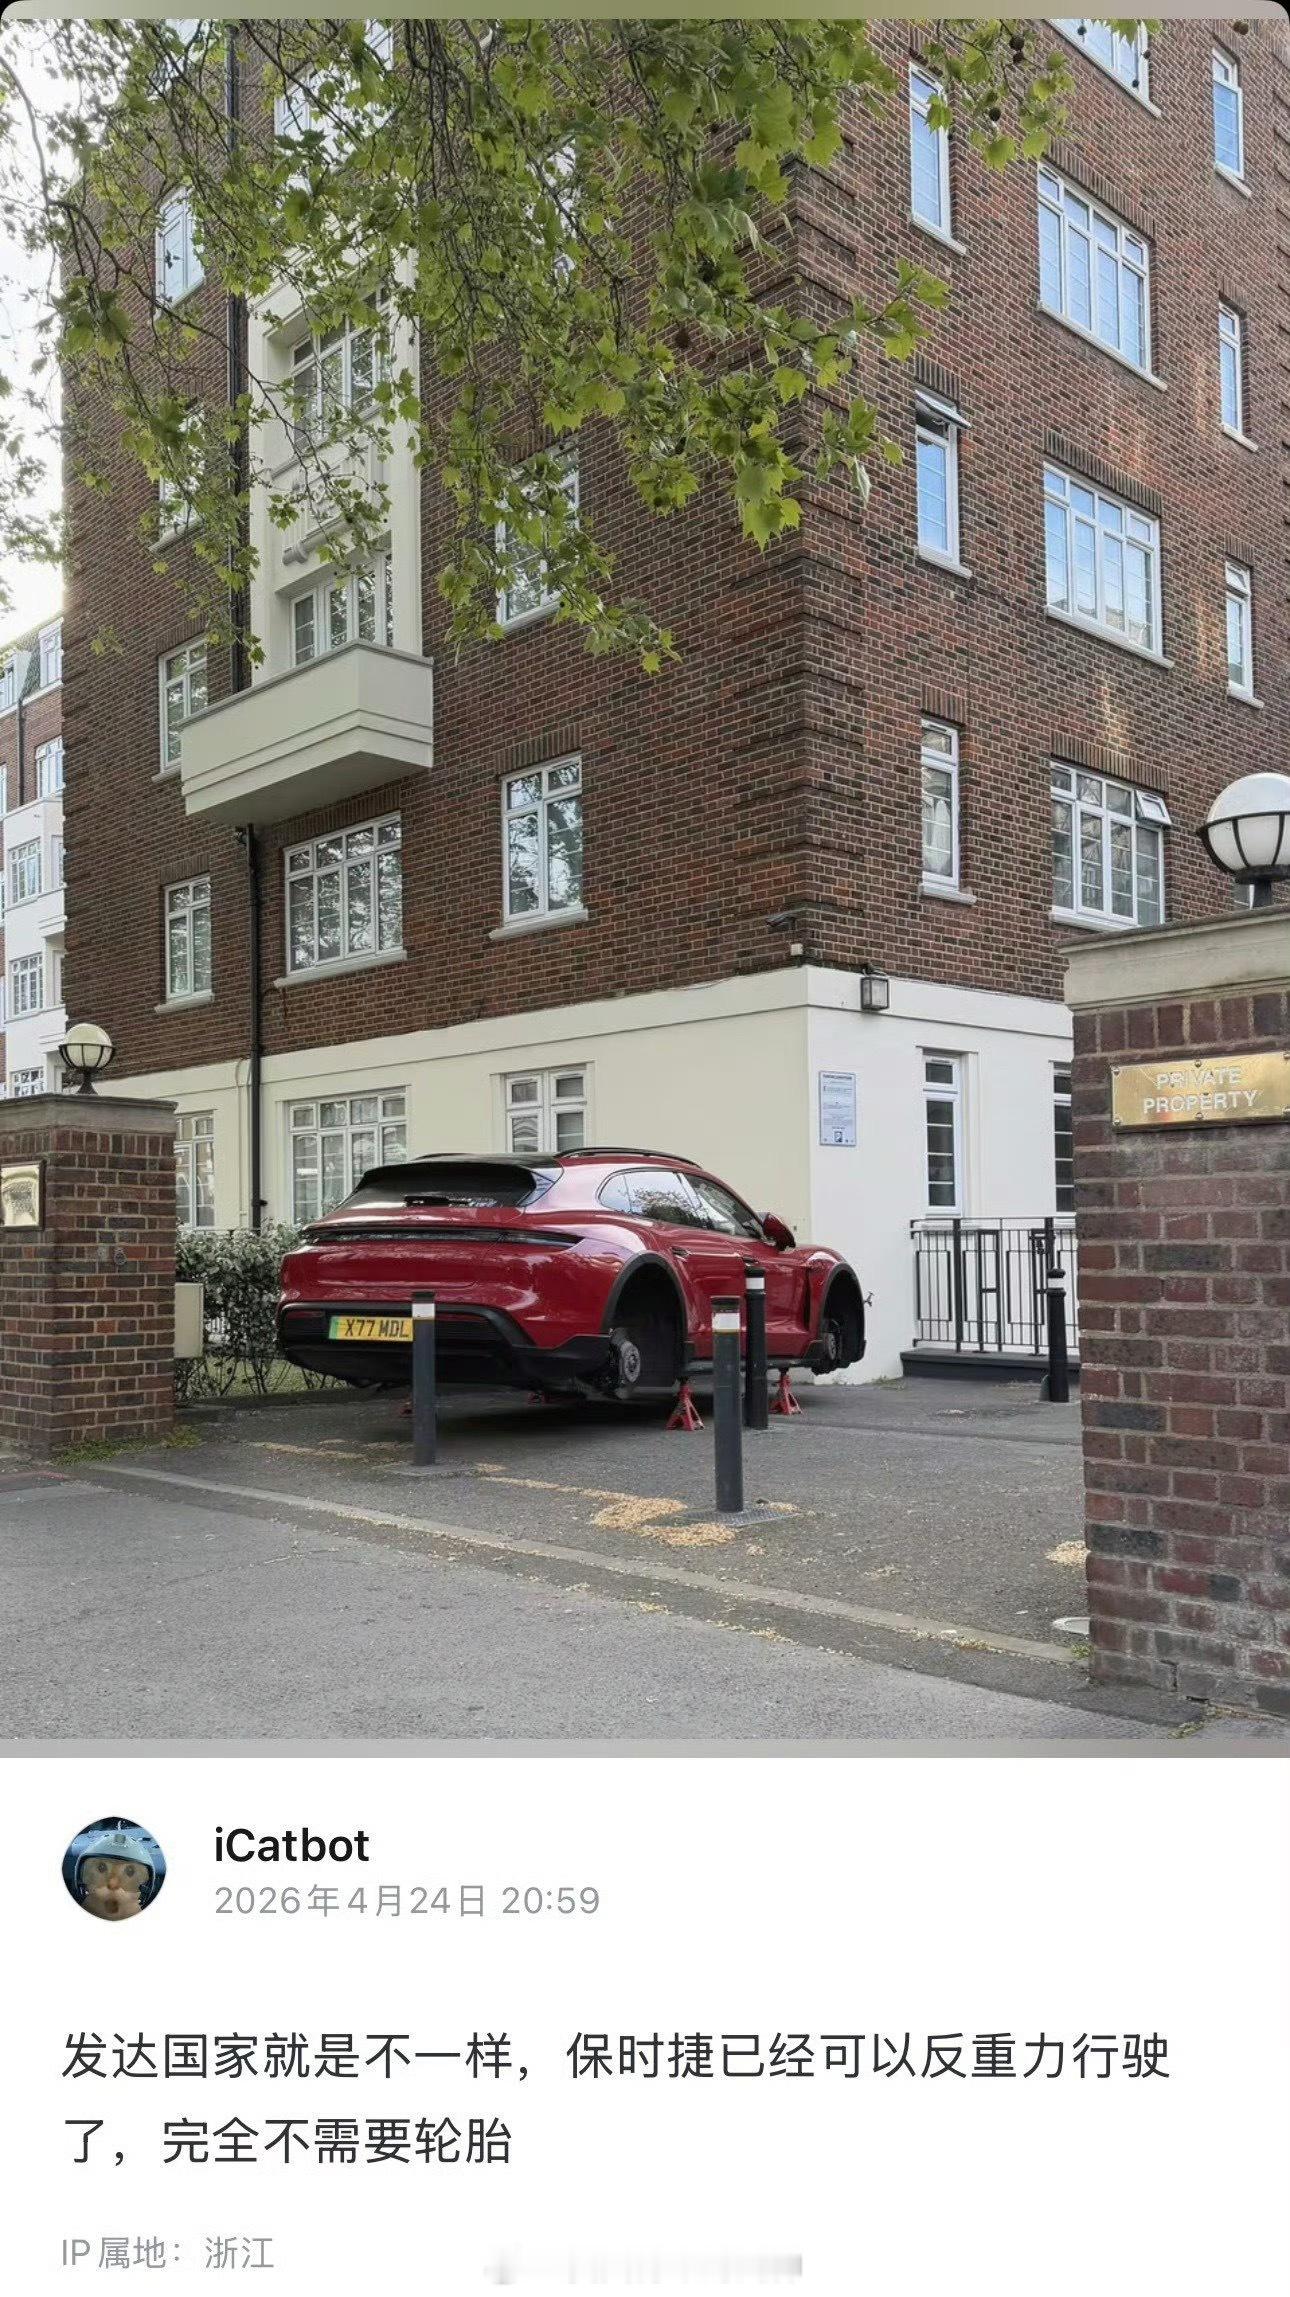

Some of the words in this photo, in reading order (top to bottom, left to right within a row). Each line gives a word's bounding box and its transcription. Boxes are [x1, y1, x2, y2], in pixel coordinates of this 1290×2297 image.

[1156, 1067, 1242, 1090] PRIVATE
[1143, 1090, 1259, 1114] PROPERTY
[344, 1319, 376, 1337] X77
[378, 1319, 410, 1338] MDL
